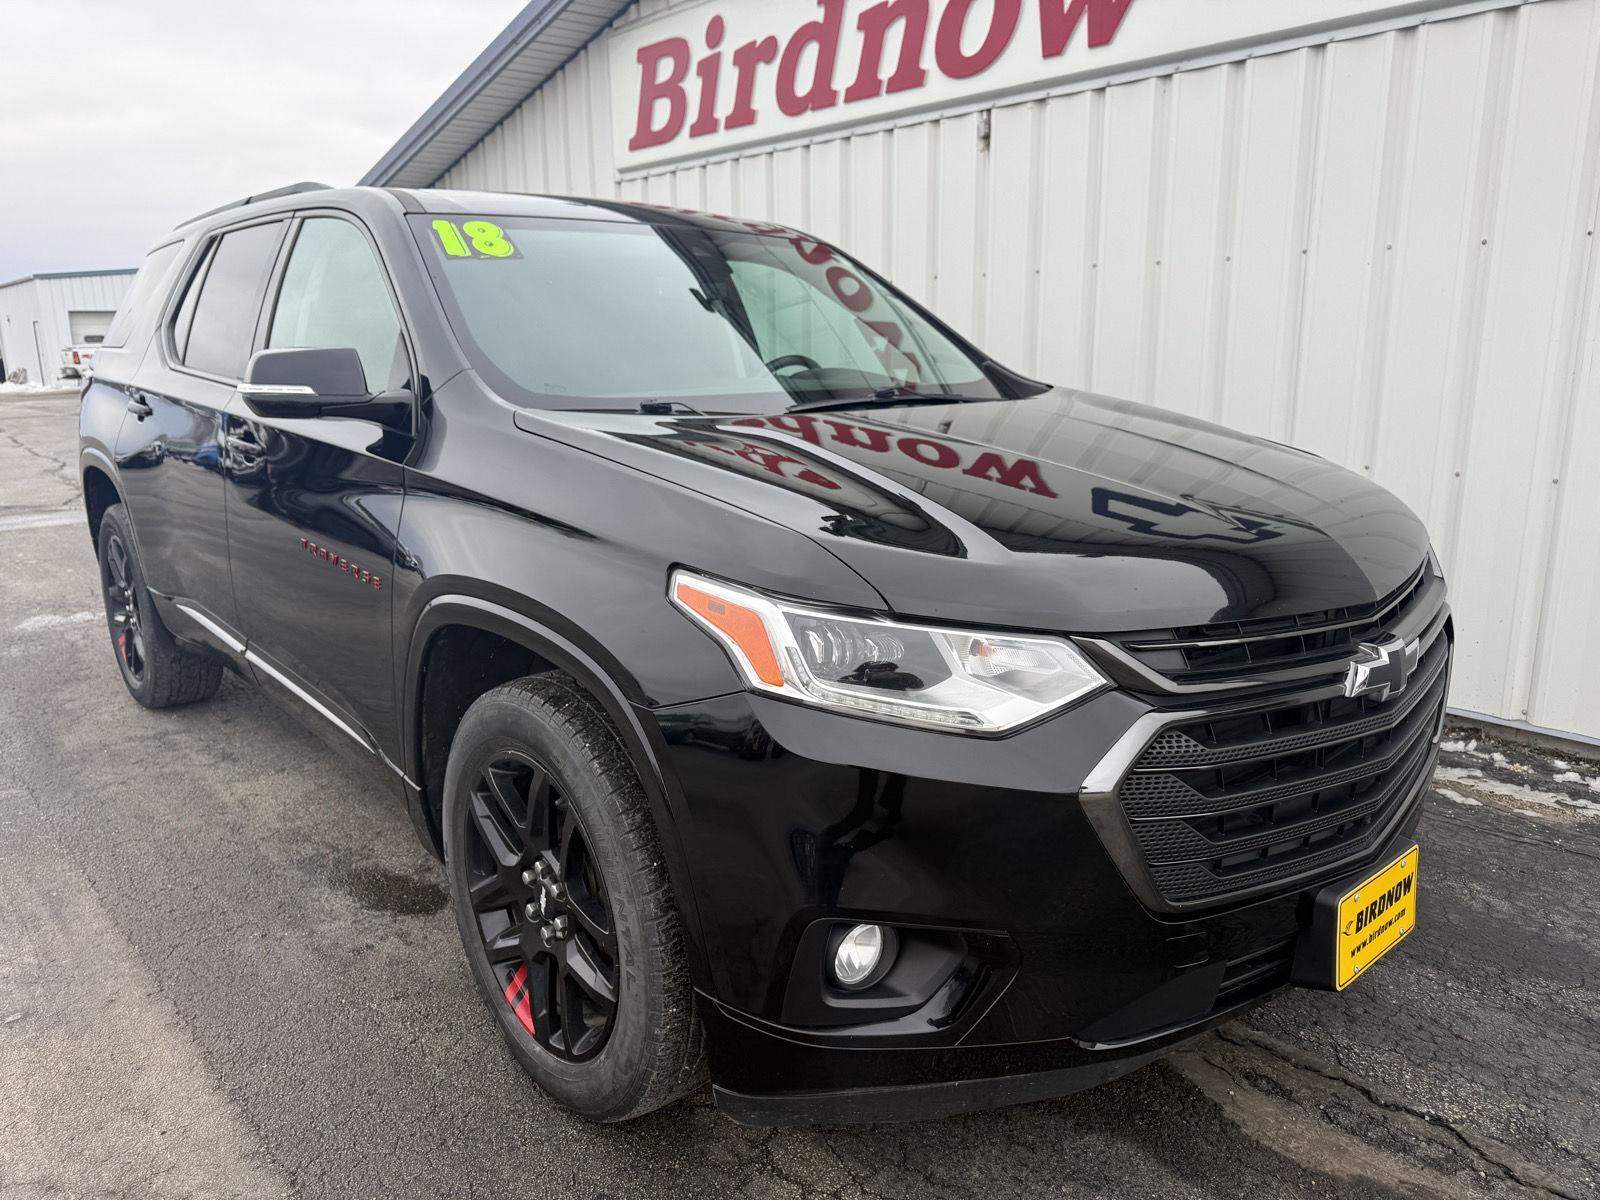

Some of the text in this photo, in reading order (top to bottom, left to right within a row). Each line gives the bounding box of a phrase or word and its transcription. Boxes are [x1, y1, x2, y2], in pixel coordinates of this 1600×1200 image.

[629, 0, 1134, 151] Birdnow
[432, 220, 514, 257] 18
[301, 537, 382, 592] TRAVERSE
[1355, 872, 1414, 934] BIRDNOW
[1350, 908, 1406, 958] www.birdnow.com
